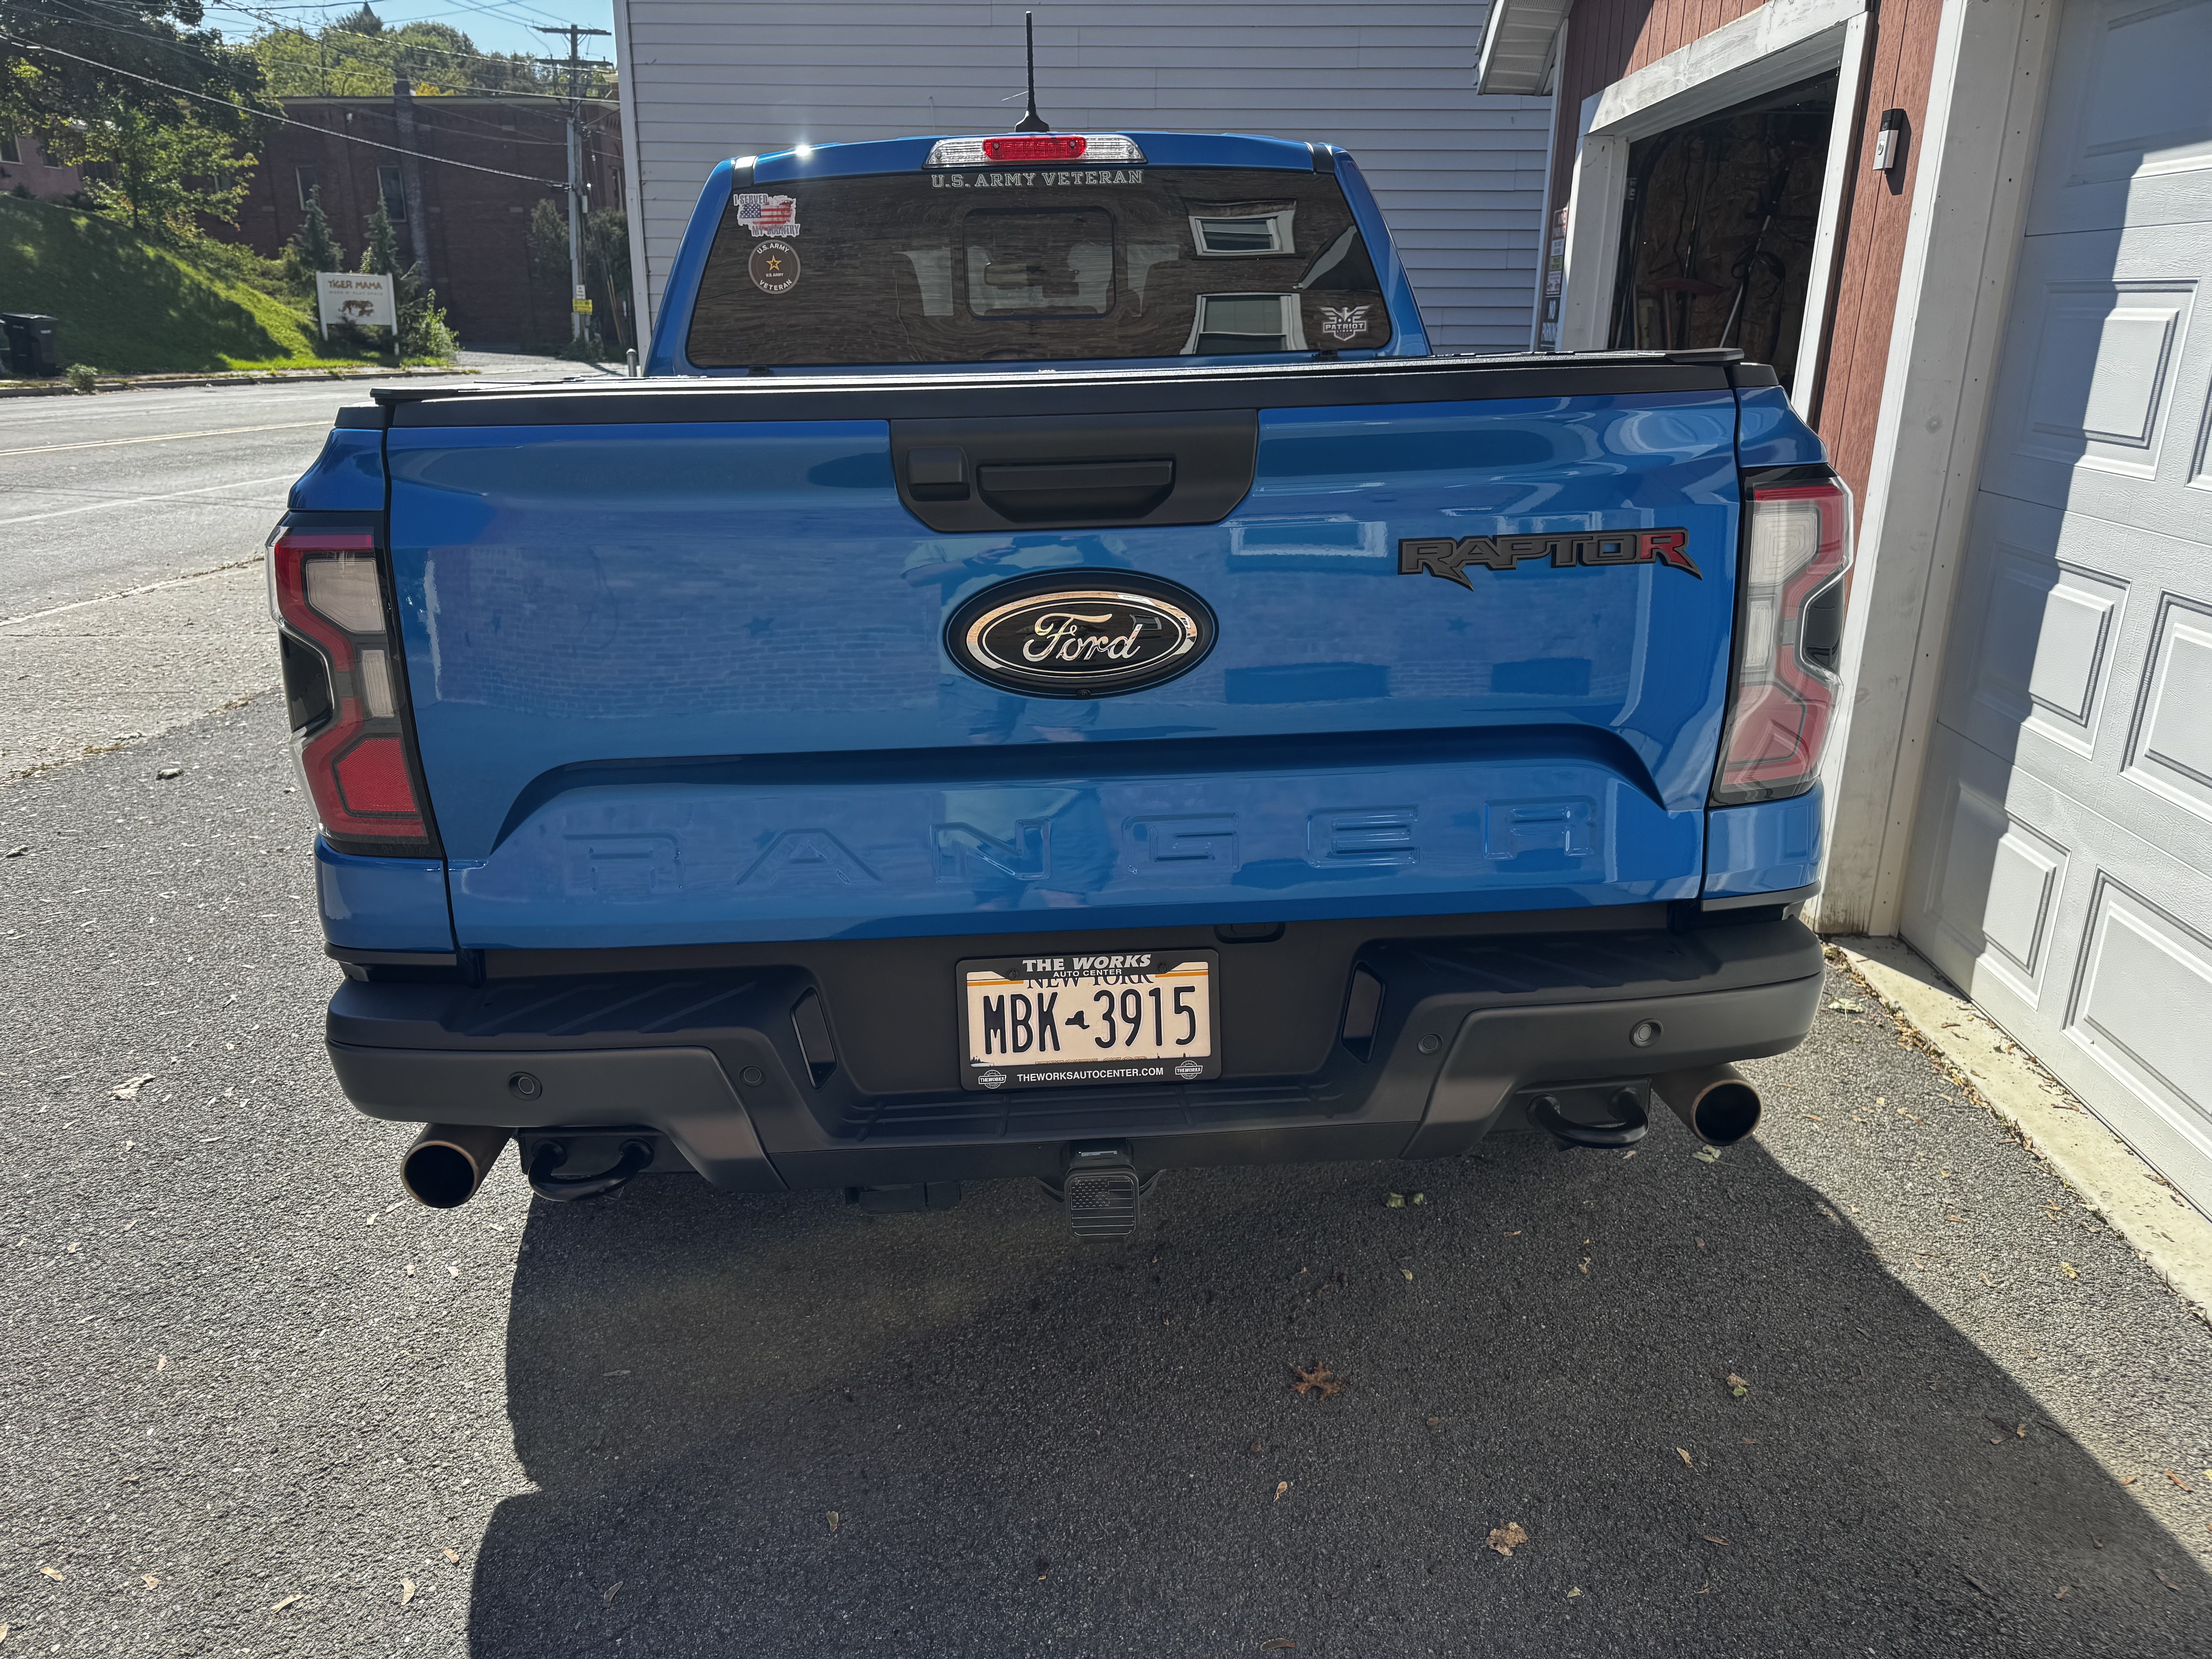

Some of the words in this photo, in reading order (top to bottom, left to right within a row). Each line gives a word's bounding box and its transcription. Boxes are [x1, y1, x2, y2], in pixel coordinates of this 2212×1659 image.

[931, 174, 970, 187] U.S.
[975, 173, 1036, 187] ARMY
[1042, 170, 1144, 185] VETERAN
[740, 194, 768, 204] SERVED
[752, 225, 764, 236] MY
[757, 245, 769, 254] U.S.
[769, 243, 789, 253] ARMY
[328, 279, 352, 289] TIGER
[759, 279, 792, 291] VETERAN
[1398, 526, 1703, 591] RAPTOR
[1022, 613, 1140, 662] Ford
[562, 795, 1597, 895] RANGER
[1023, 958, 1065, 972] THE
[1072, 954, 1151, 970] WORKS
[1017, 1067, 1163, 1082] THEWORKSAUTOCENTER.COM
